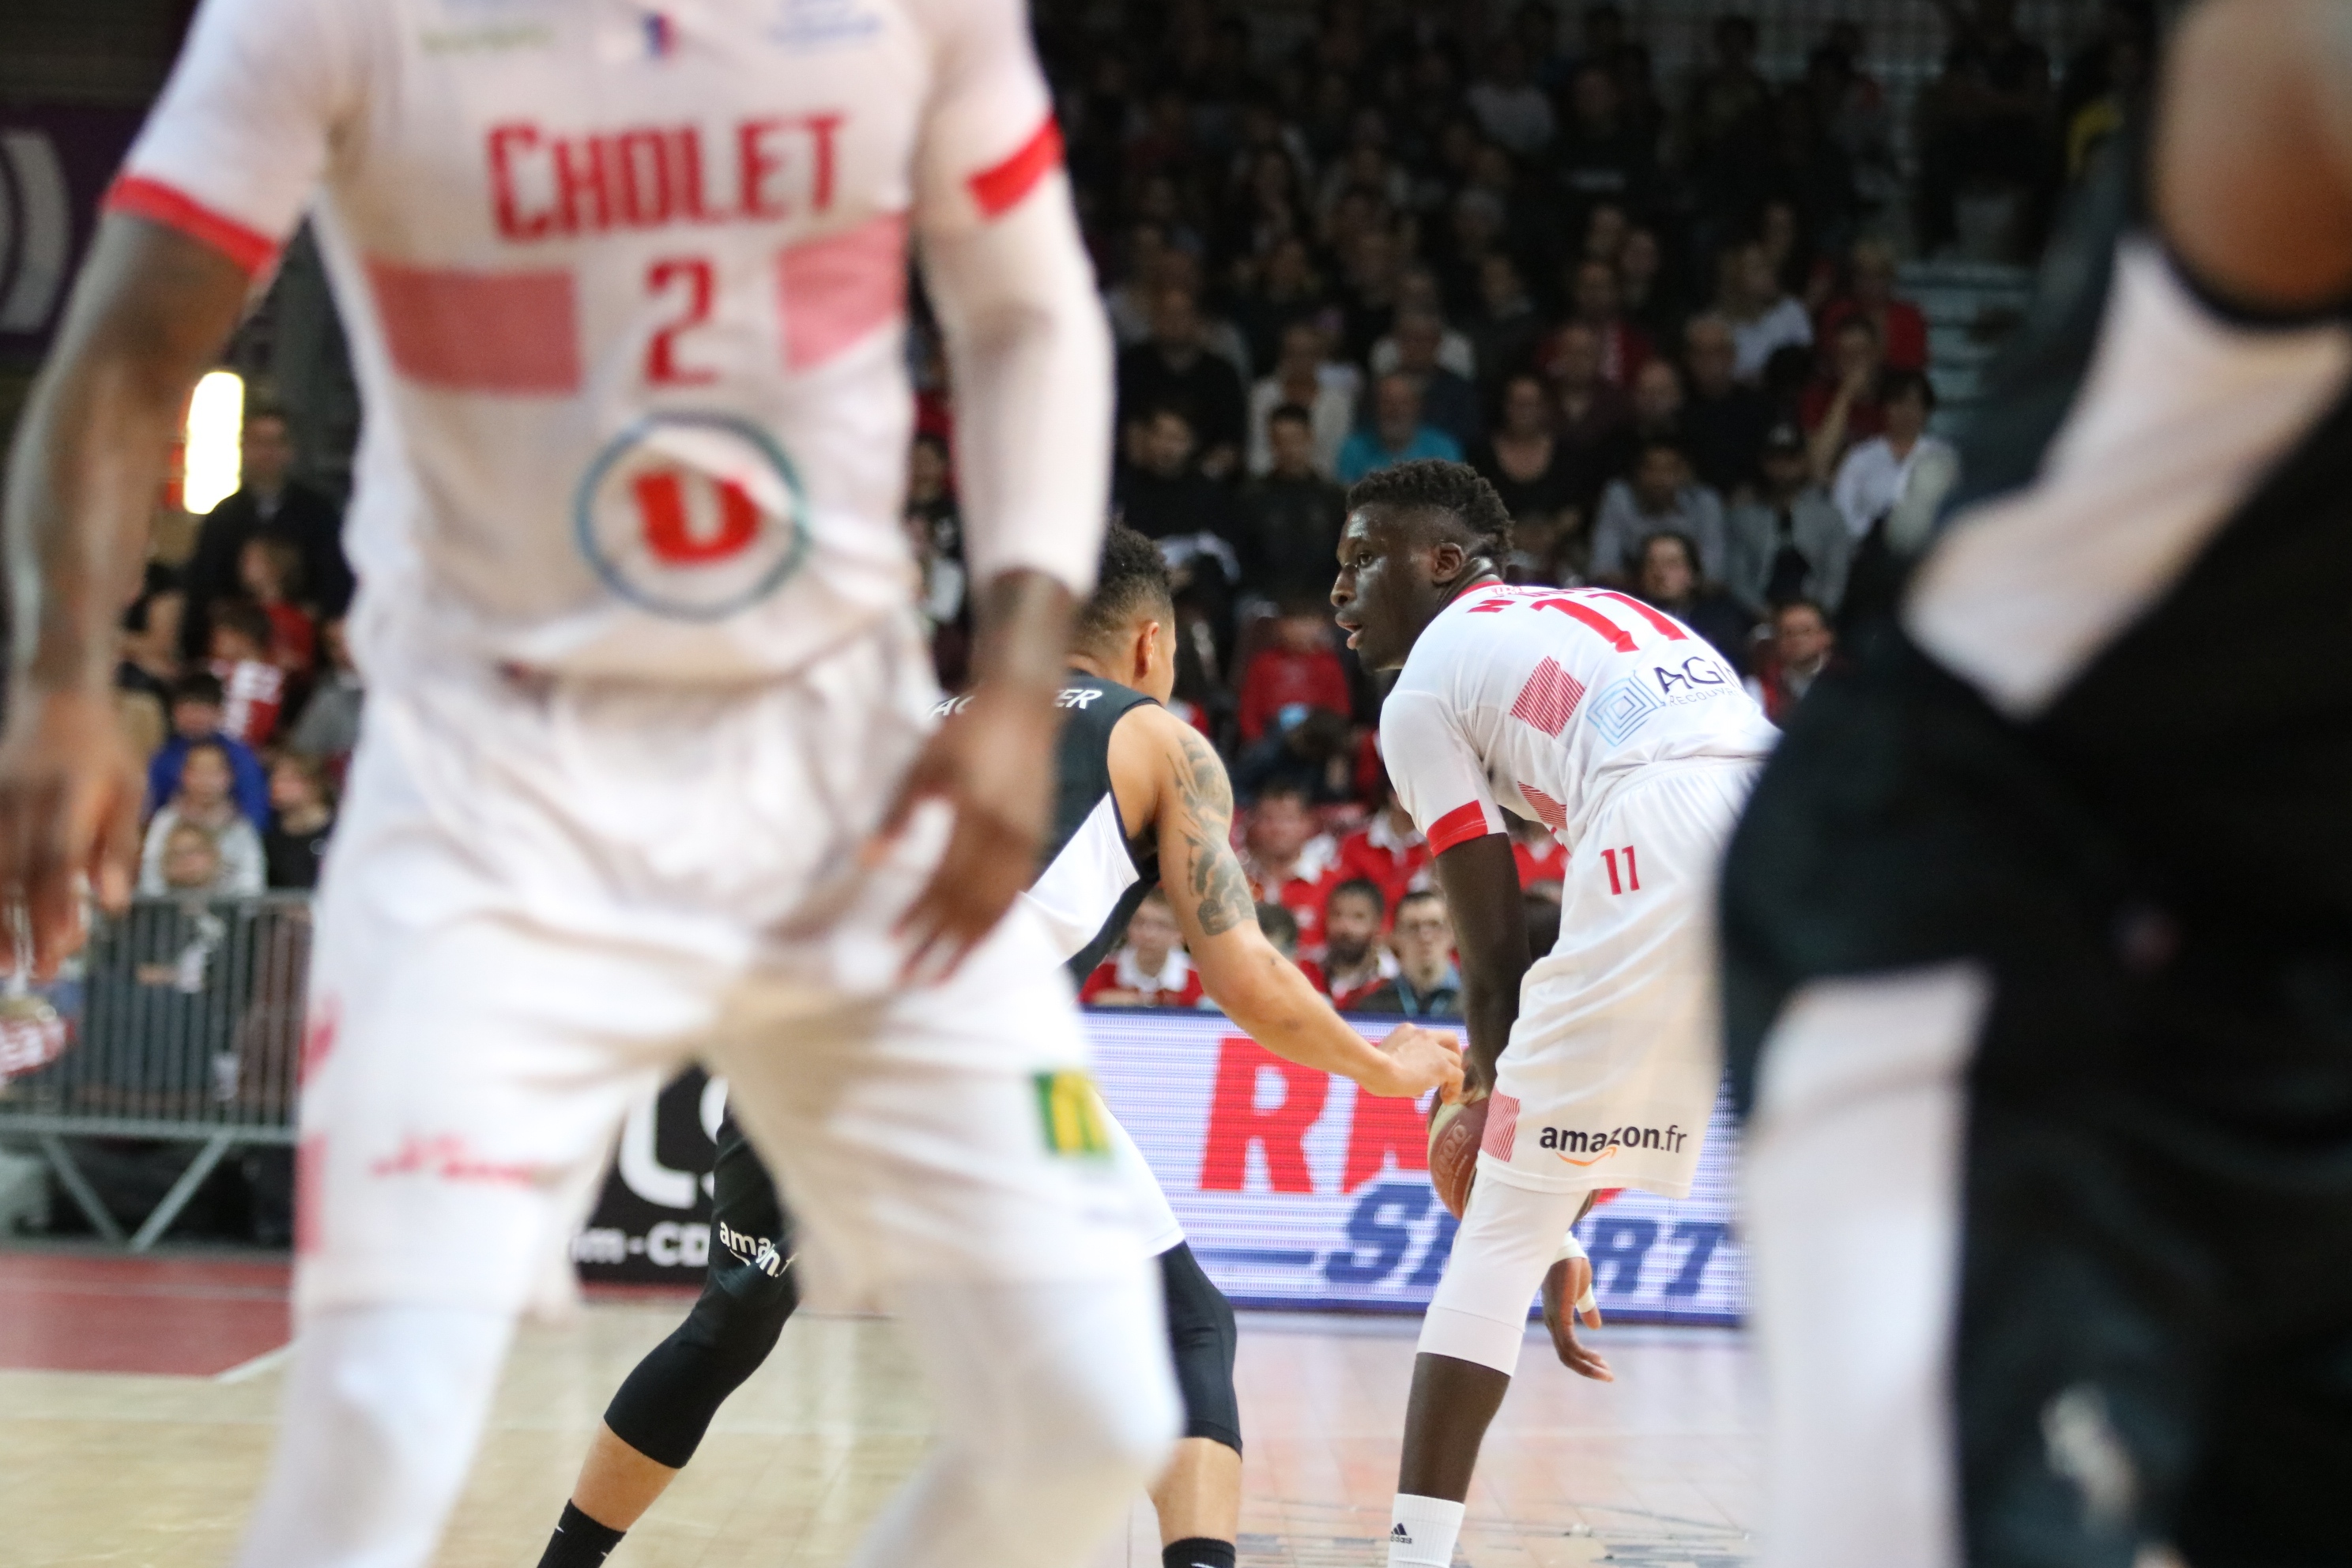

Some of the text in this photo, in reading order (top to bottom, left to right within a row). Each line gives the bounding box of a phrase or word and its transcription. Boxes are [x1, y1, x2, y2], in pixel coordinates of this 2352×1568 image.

[488, 112, 846, 243] CHOLET
[646, 256, 717, 386] 2
[1530, 592, 1690, 653] 11
[1600, 845, 1640, 895] 11
[1540, 1125, 1687, 1154] amazon.fr
[1325, 1183, 1729, 1298] SRT
